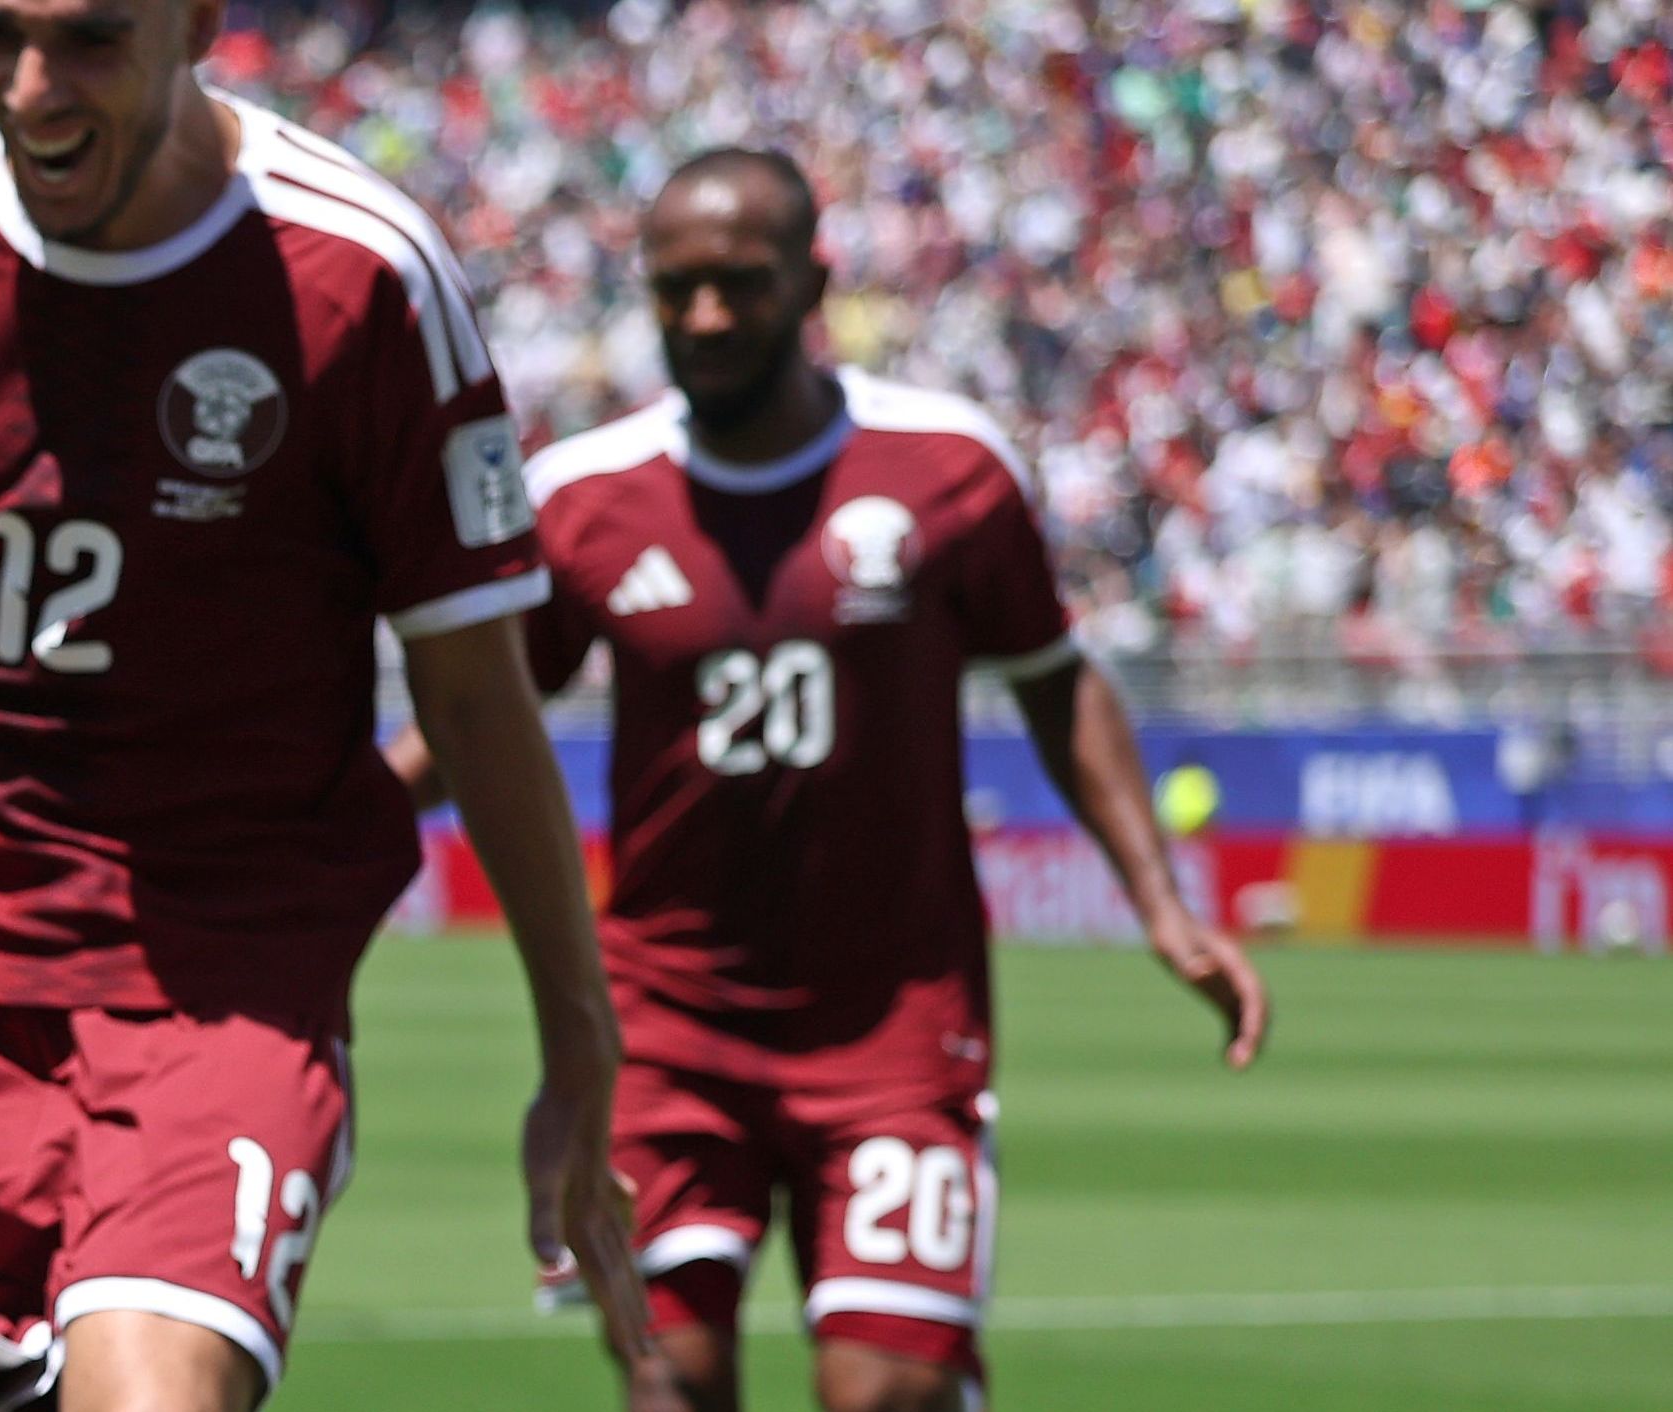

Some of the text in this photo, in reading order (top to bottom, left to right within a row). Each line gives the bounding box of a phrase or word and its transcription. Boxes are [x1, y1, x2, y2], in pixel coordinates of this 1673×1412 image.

[695, 638, 837, 776] 20
[227, 1136, 319, 1332] 12
[843, 1135, 974, 1271] 20
